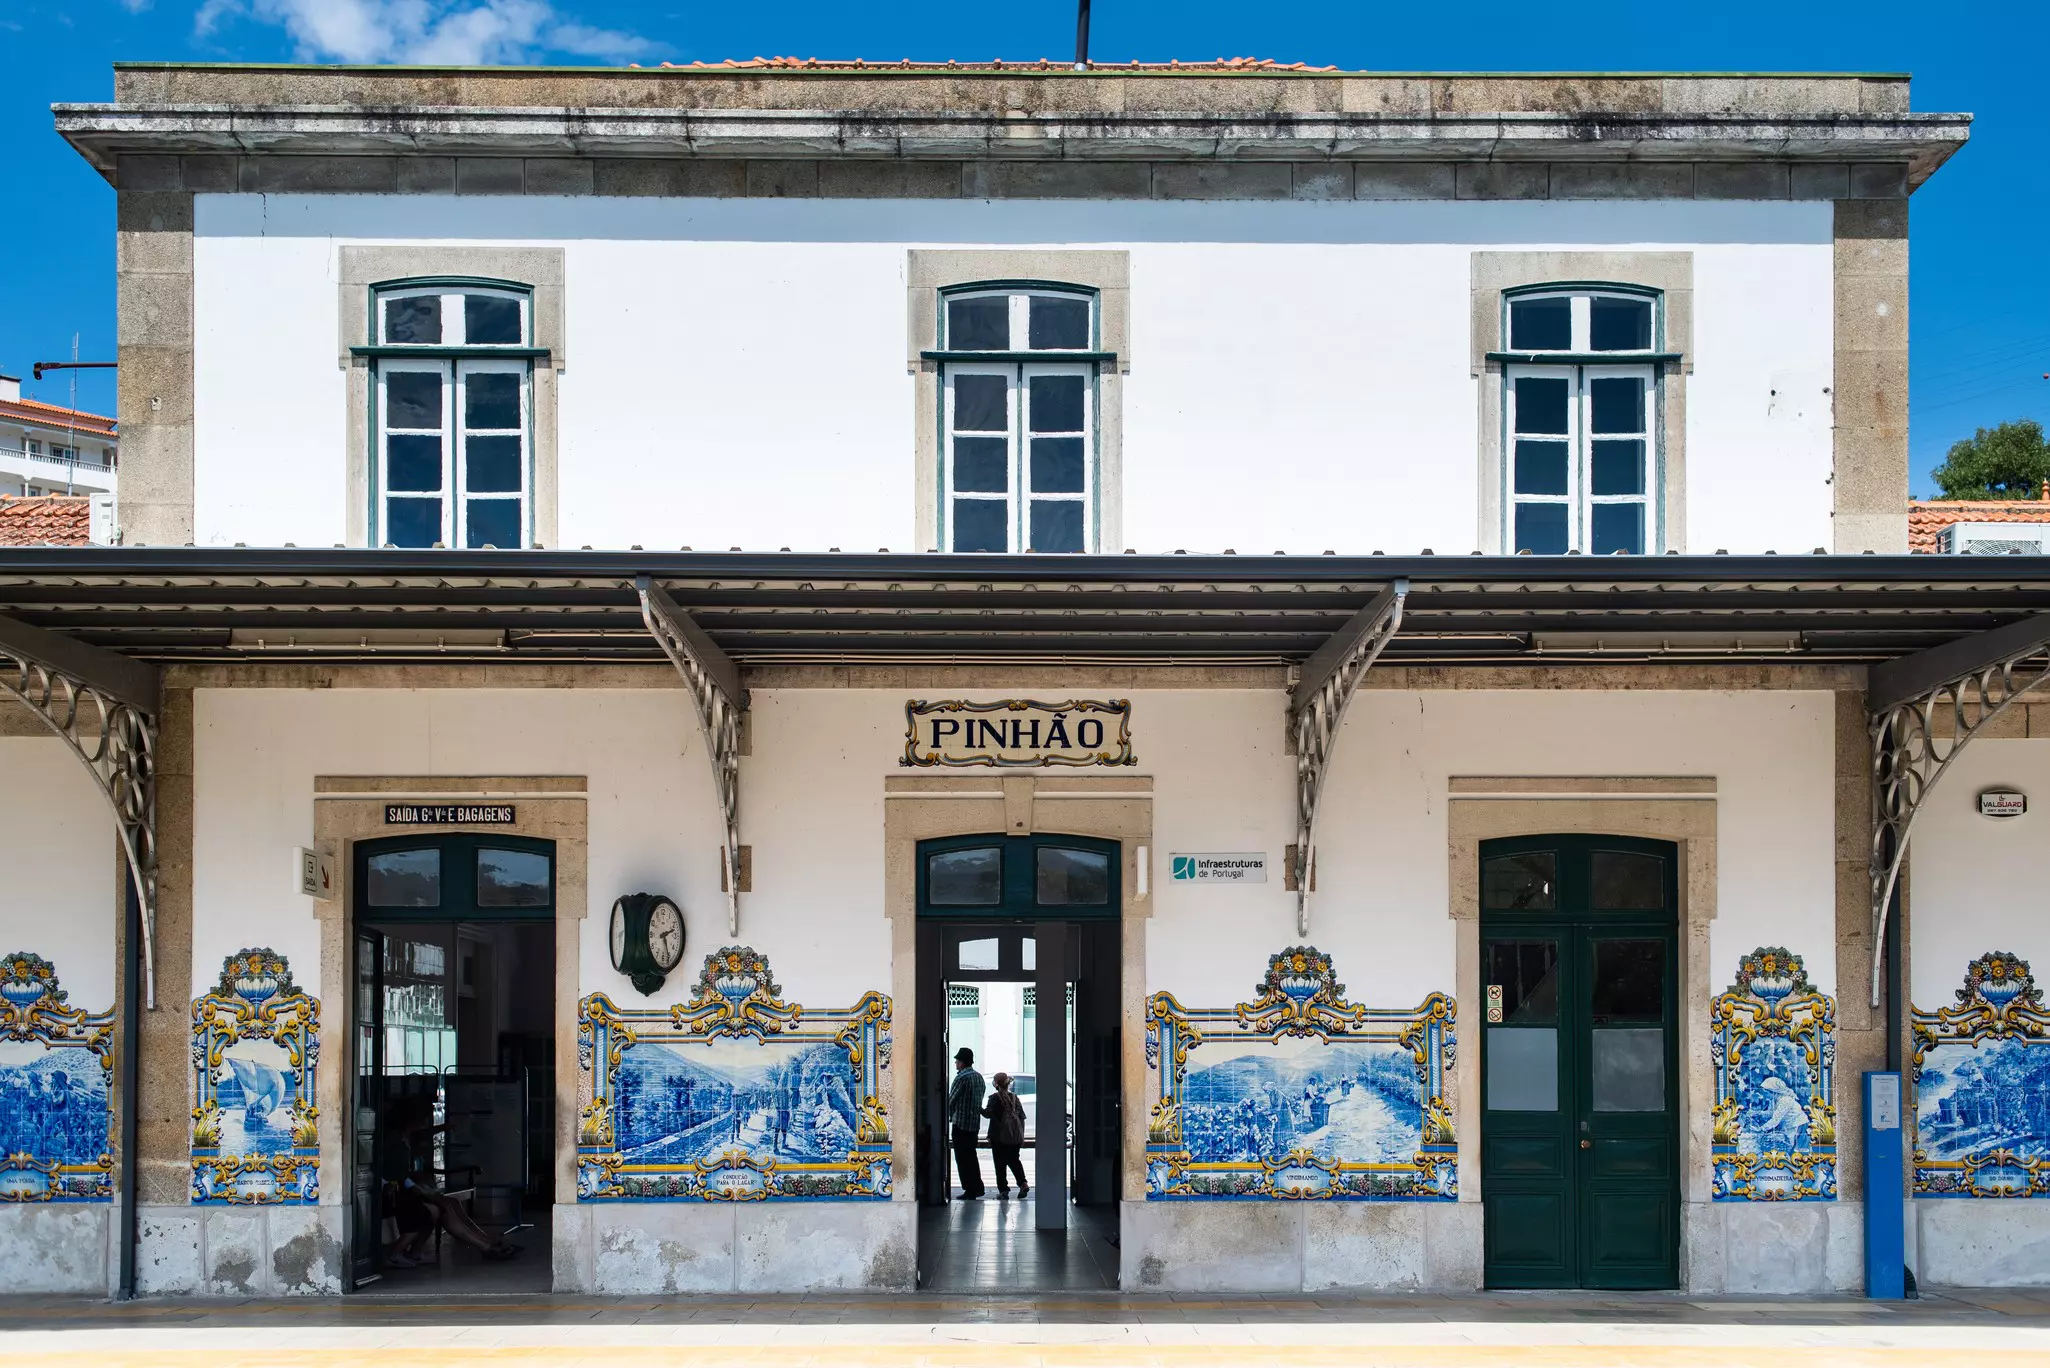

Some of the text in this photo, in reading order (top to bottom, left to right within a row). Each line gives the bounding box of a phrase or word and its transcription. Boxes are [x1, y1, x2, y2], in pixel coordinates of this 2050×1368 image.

[930, 712, 1104, 749] PINHÃO
[389, 806, 419, 822] SAÍDA
[448, 808, 455, 822] E
[457, 808, 511, 822] BAGAGENS
[1198, 860, 1263, 868] Infraestruturas
[1198, 869, 1244, 880] de Portugal
